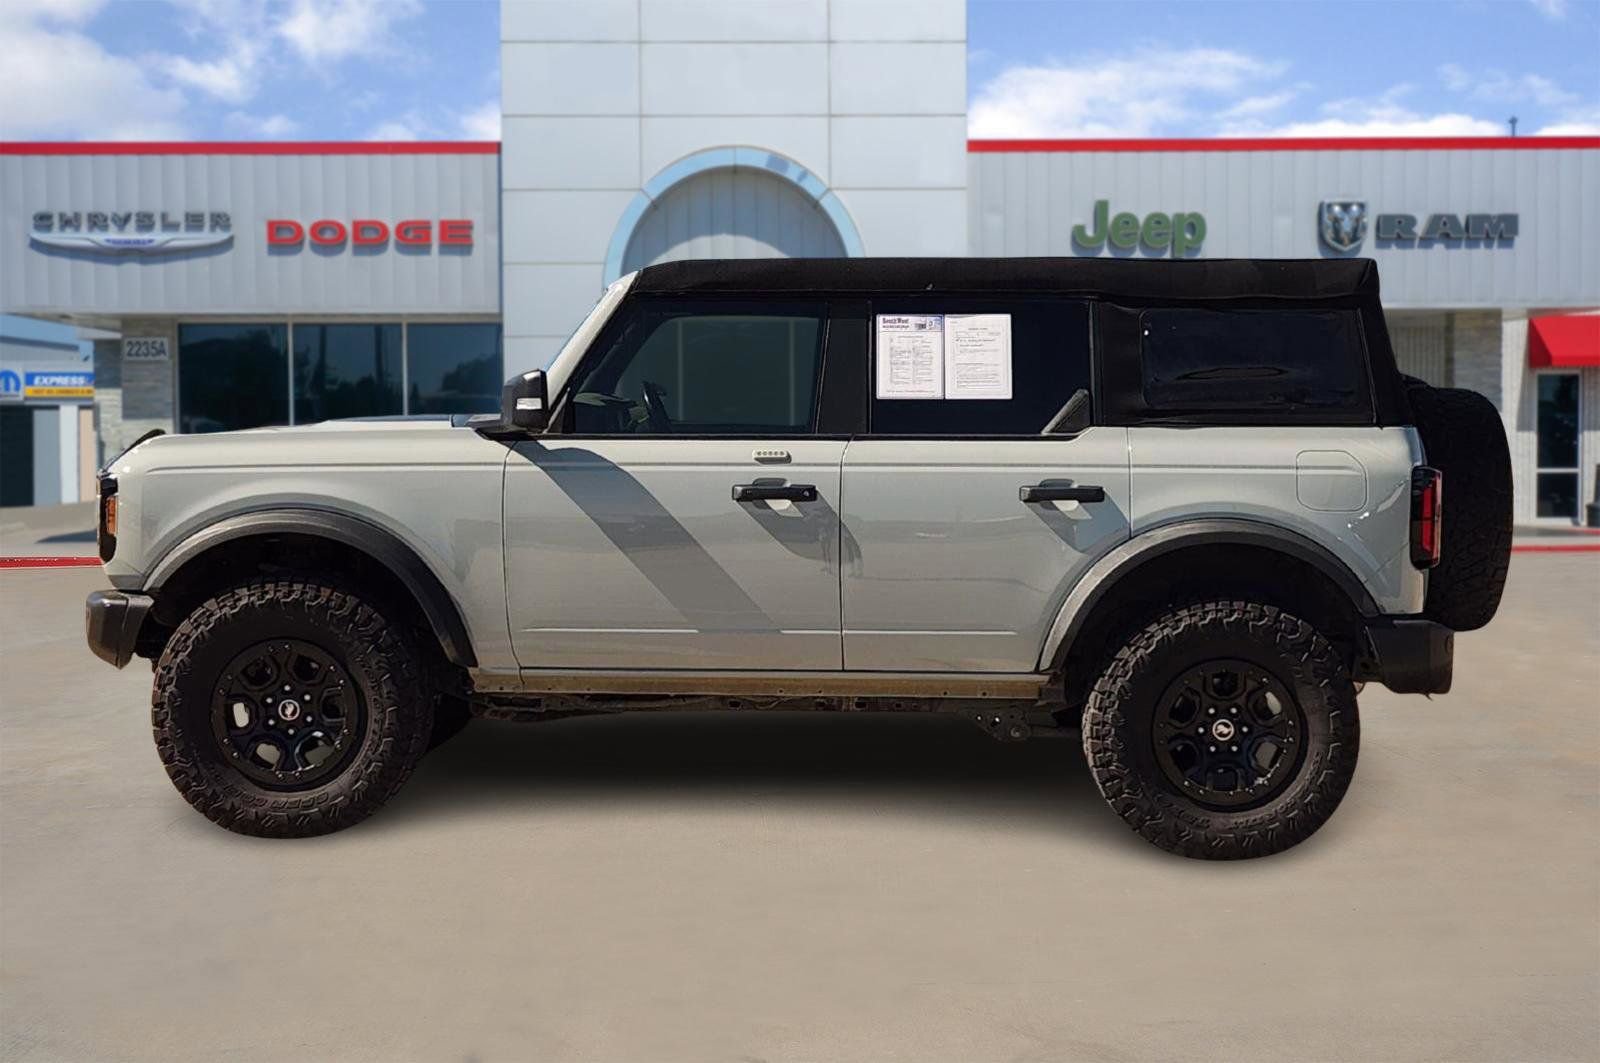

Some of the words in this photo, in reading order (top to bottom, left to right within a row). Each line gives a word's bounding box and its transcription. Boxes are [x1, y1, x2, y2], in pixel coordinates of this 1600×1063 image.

[33, 211, 231, 231] CHRYSLER
[266, 219, 474, 246] DODGE
[1070, 200, 1206, 258] Jeep
[1376, 213, 1519, 239] RAM
[126, 341, 166, 357] 2235A
[33, 375, 86, 385] EXPRESS
